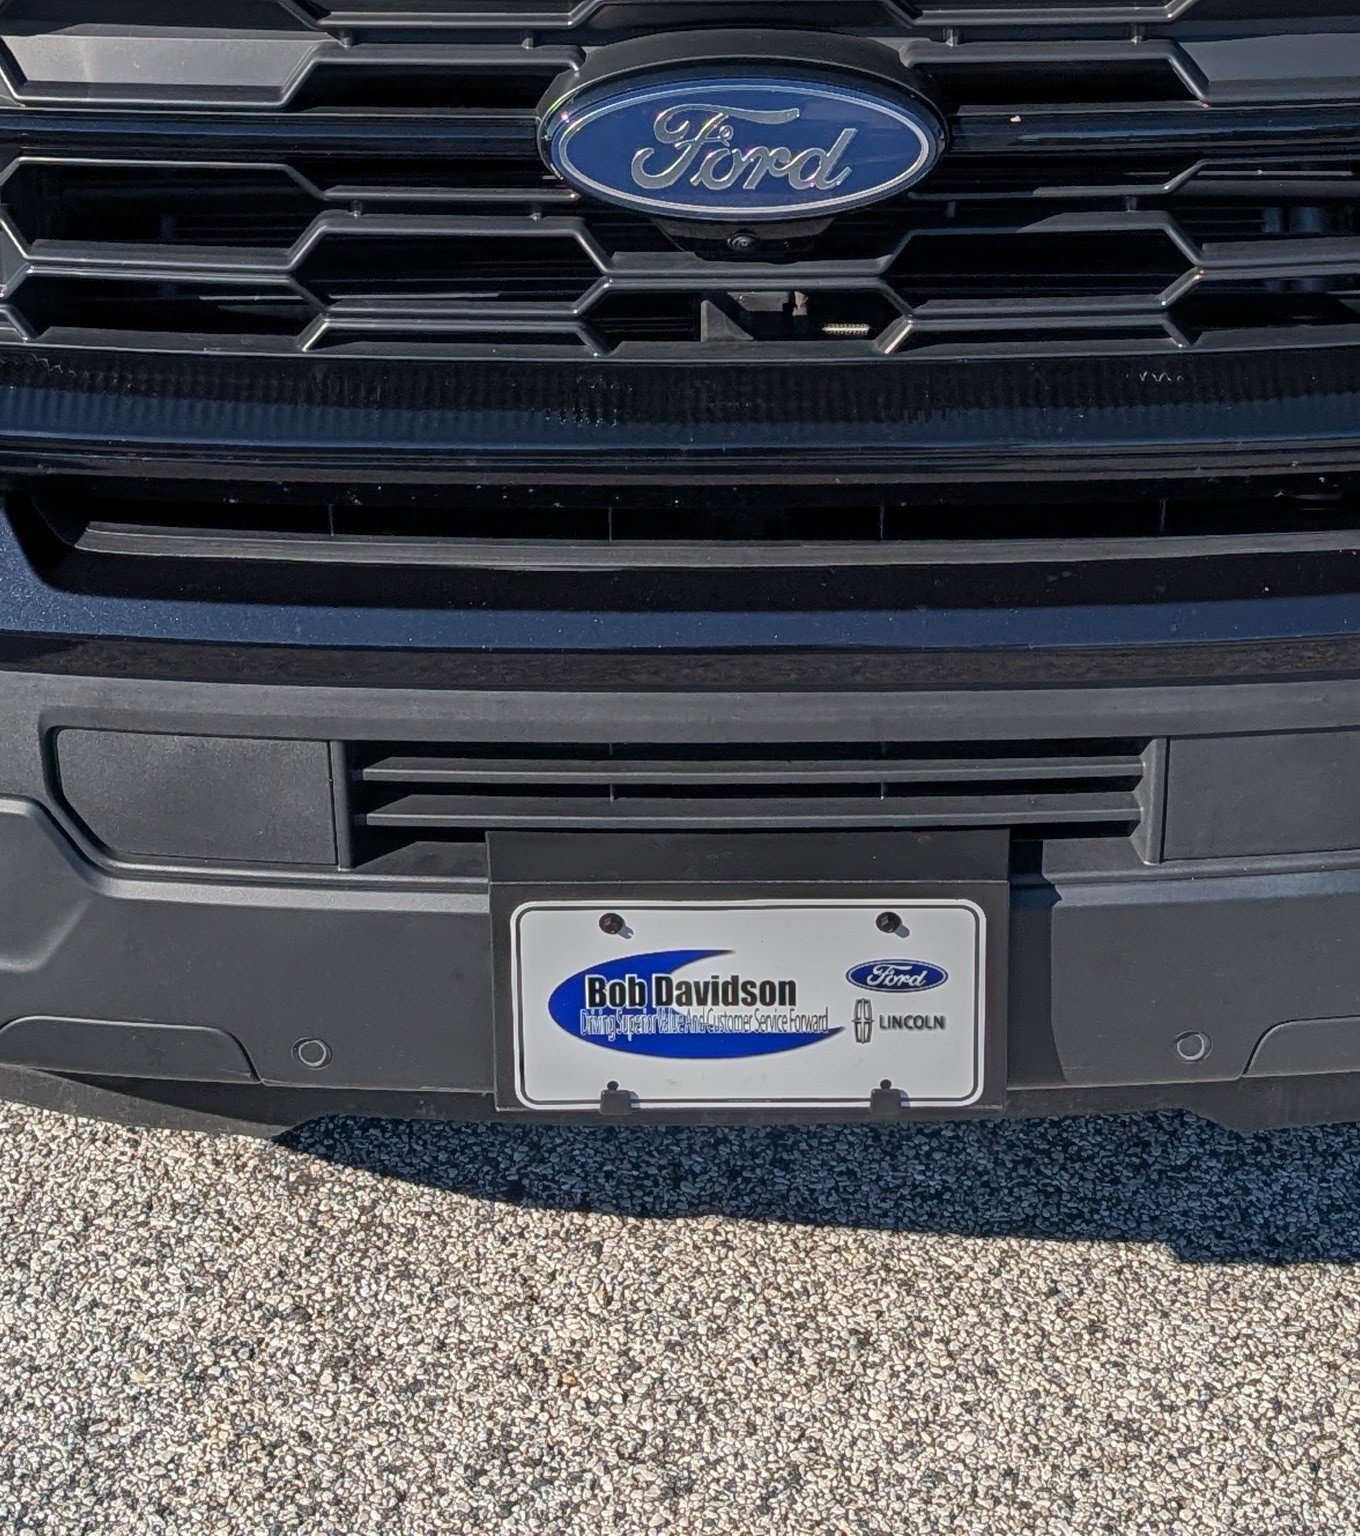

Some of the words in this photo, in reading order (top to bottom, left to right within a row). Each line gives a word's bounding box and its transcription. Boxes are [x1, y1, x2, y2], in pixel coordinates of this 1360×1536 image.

[631, 103, 859, 191] Ford
[586, 974, 648, 1009] Bob
[652, 973, 797, 1008] Davidson
[866, 963, 928, 987] Ford
[580, 1008, 616, 1042] Driving
[615, 1009, 658, 1042] Superior
[706, 1008, 753, 1034] Customer
[754, 1008, 788, 1034] Service
[788, 1007, 829, 1034] Forward
[878, 1014, 946, 1031] LINCOLN
